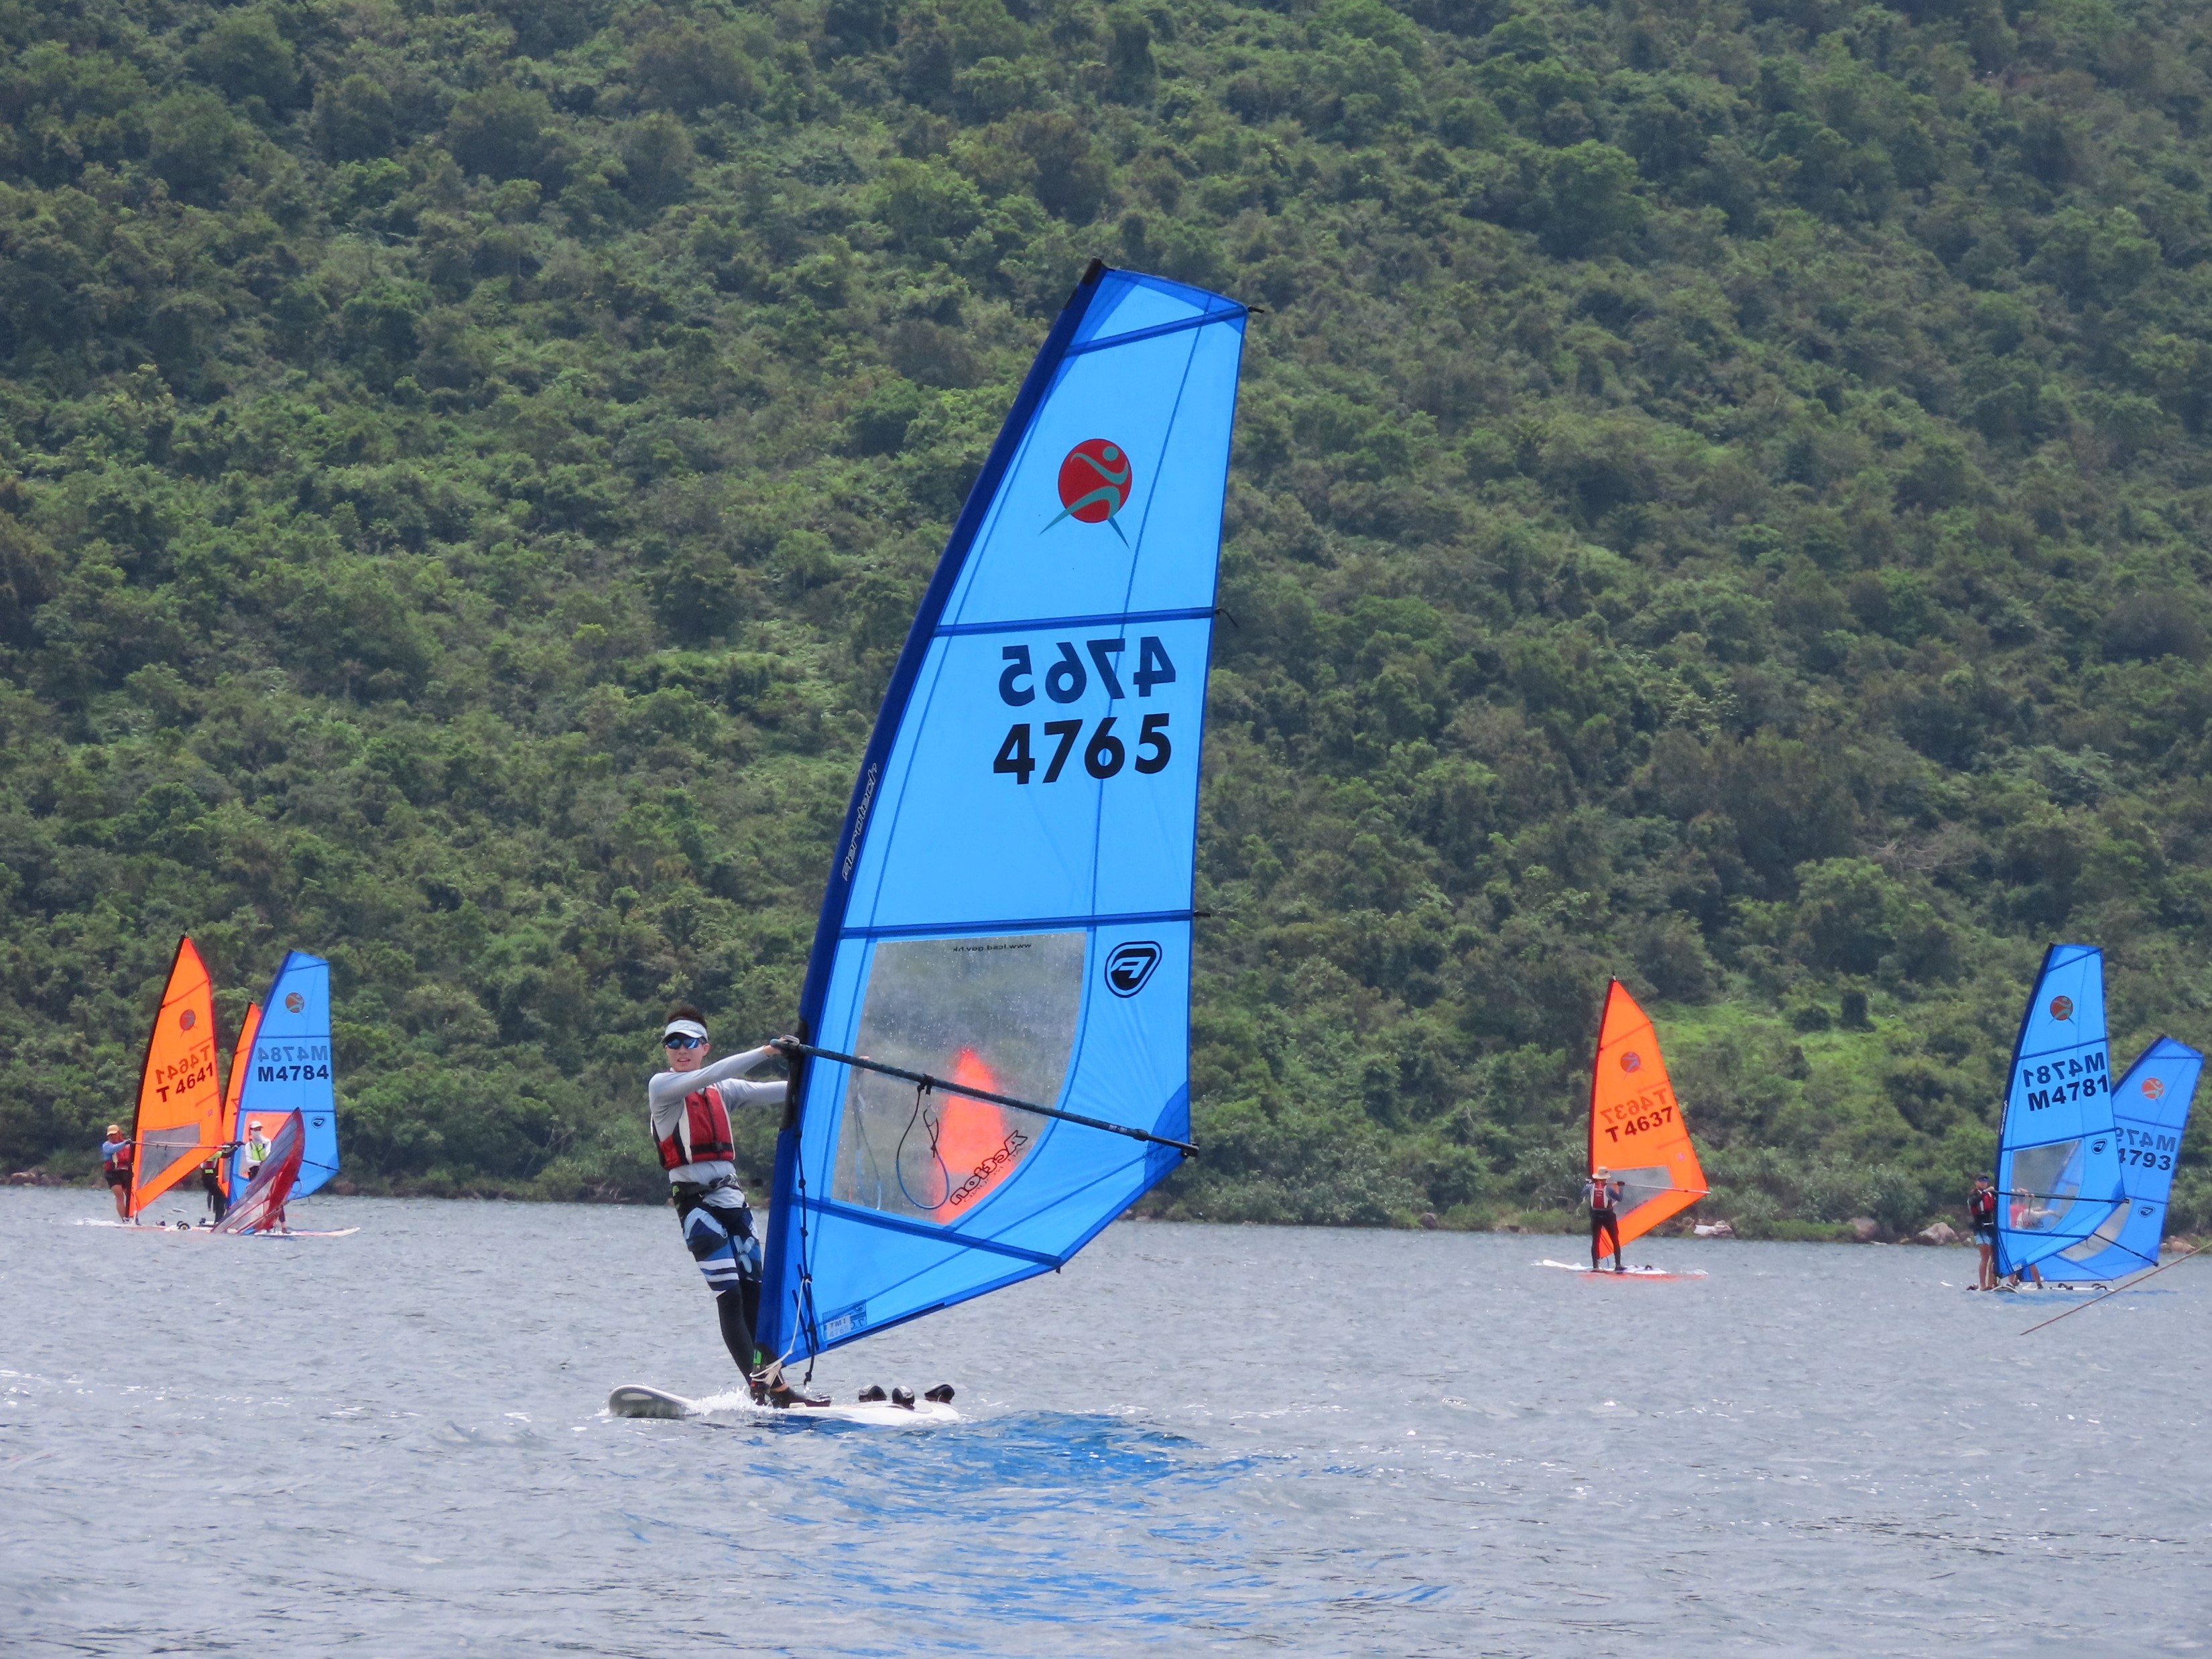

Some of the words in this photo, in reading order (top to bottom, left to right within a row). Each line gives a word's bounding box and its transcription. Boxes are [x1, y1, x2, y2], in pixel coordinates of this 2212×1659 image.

[993, 713, 1172, 785] 4765
[257, 1064, 329, 1082] M4784
[2028, 1074, 2108, 1111] M4781
